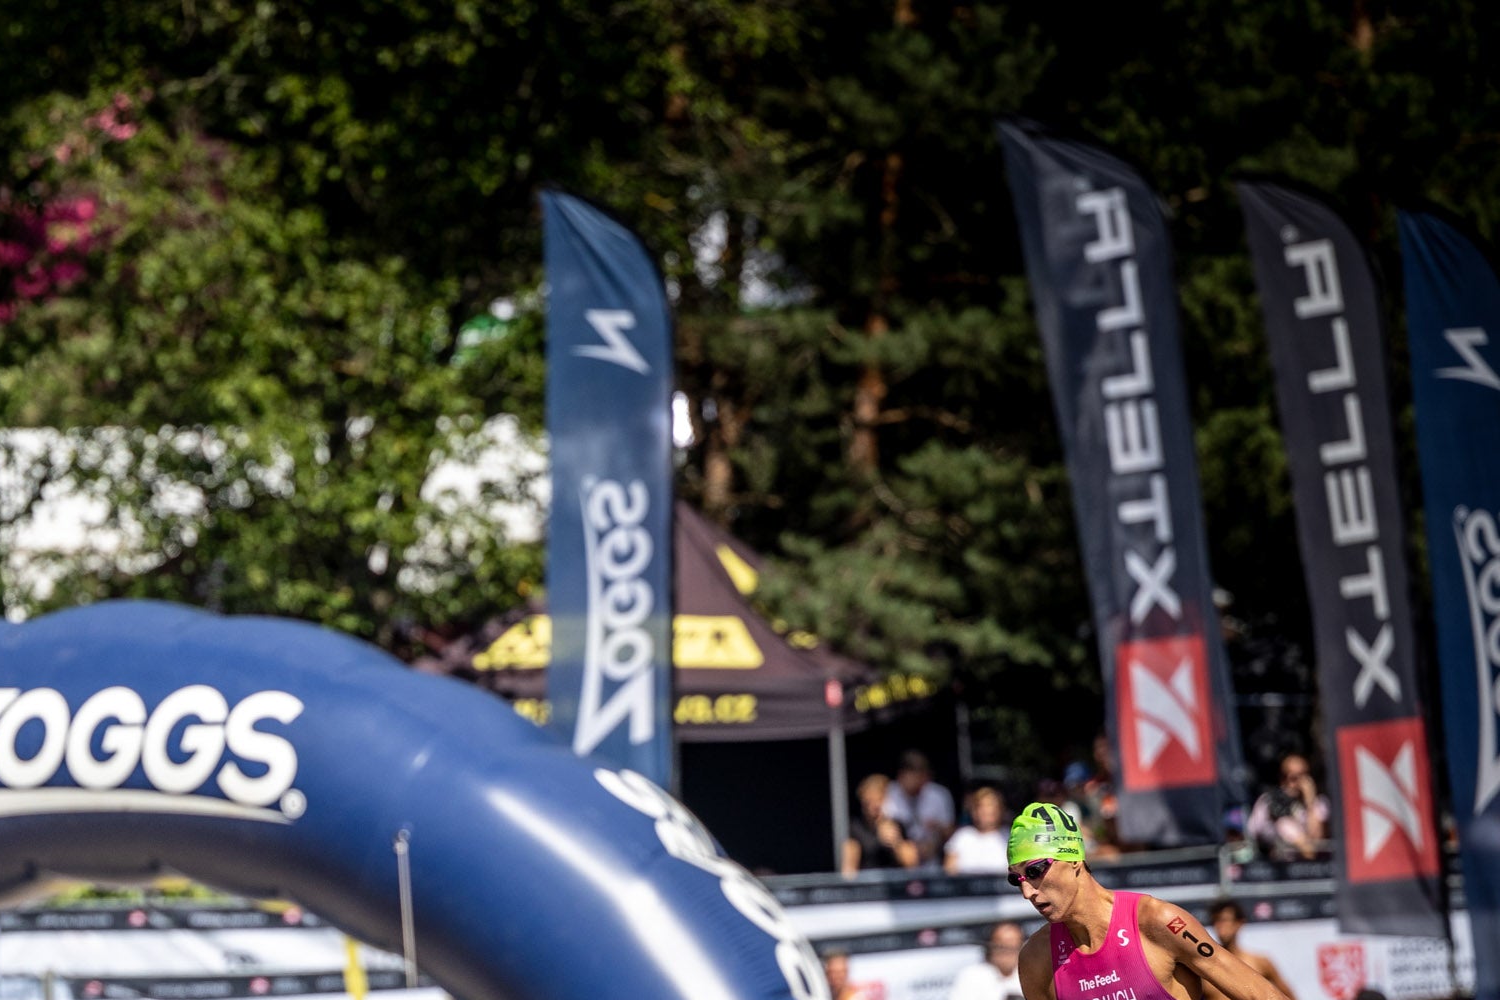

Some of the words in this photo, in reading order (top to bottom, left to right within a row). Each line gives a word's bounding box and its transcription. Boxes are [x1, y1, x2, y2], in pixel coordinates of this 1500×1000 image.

[1031, 806, 1077, 832] 10
[1182, 930, 1214, 957] 10
[1079, 979, 1095, 991] The
[1095, 969, 1120, 988] Feed.
